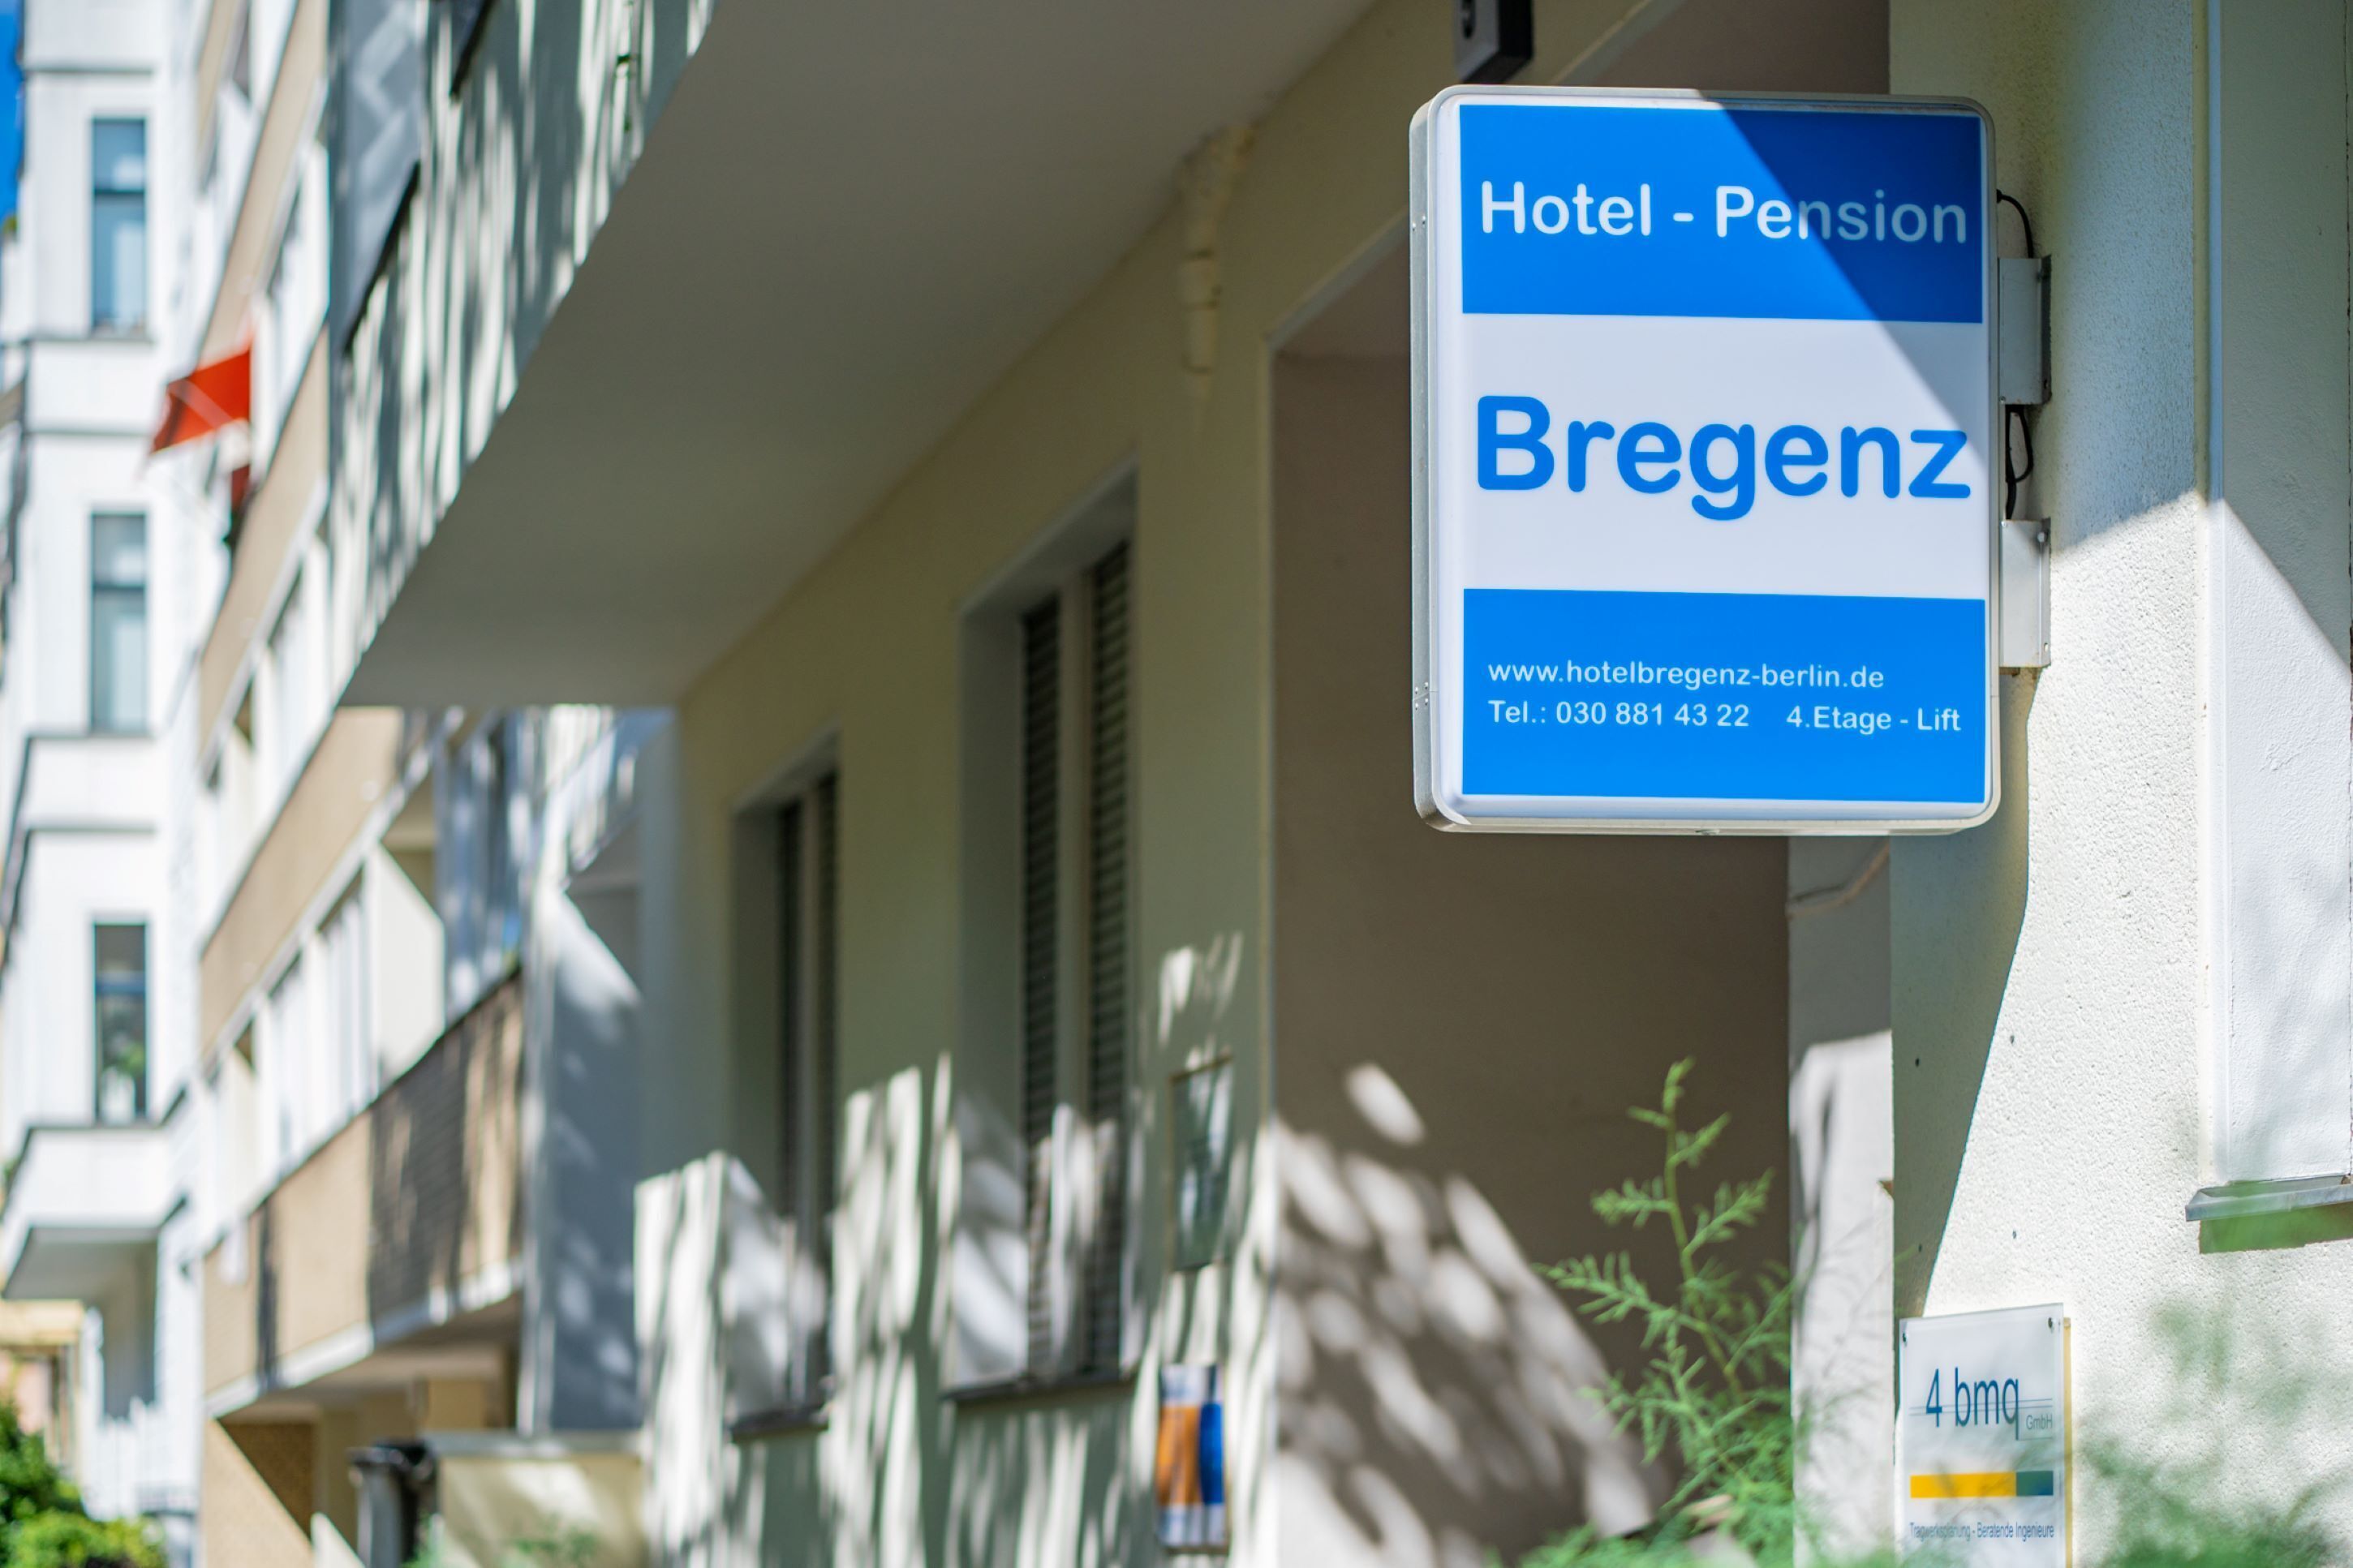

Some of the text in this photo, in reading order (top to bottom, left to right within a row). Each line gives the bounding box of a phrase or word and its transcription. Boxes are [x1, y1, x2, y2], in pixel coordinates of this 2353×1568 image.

[1481, 181, 1967, 244] Hotel - Pension
[1477, 395, 1971, 522] Bregenz
[1487, 659, 1885, 689] www.hotelbregenz-berlin.de
[1488, 700, 1546, 724] Tel.:
[1555, 702, 1605, 725] 030
[1615, 702, 1663, 726] 881
[1674, 703, 1708, 727] 43
[1716, 704, 1750, 728] 22
[1917, 708, 1962, 732] Lift
[1925, 1367, 2019, 1441] 4 bmq
[2026, 1415, 2053, 1430] GmbH
[1909, 1522, 1972, 1541] Tragwerksplanung
[1977, 1523, 2014, 1539] Beratende
[2015, 1522, 2054, 1541] Ingenieure
